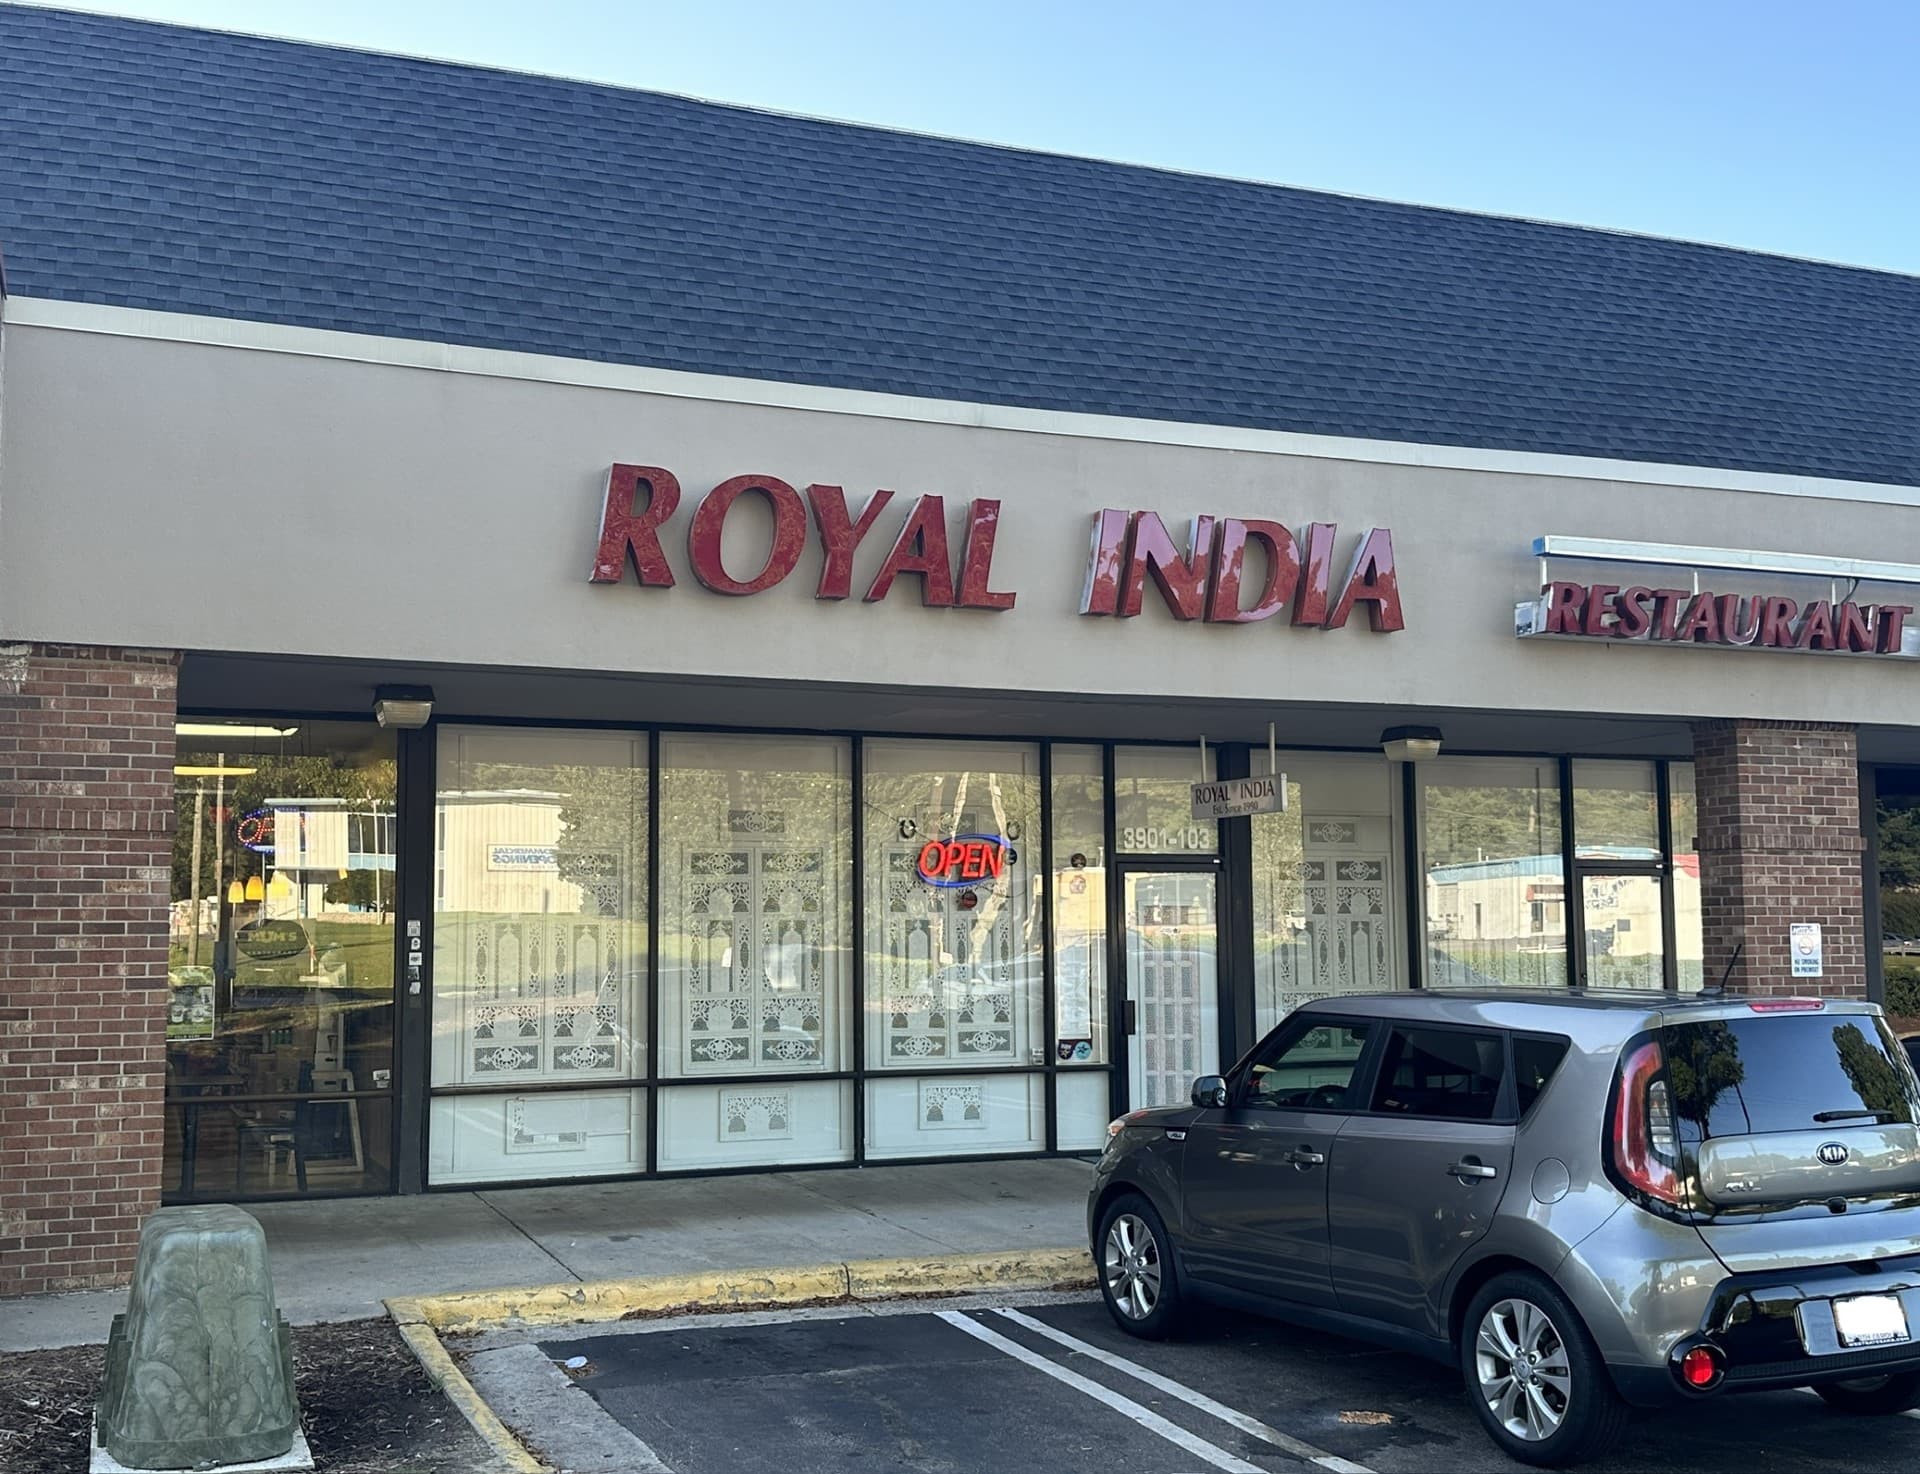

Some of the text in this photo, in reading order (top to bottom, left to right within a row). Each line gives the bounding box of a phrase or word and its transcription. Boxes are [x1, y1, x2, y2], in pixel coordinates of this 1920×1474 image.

[588, 462, 1913, 654] ROYAL INDIA RESTAURANT
[1195, 780, 1275, 805] ROYAL INDIA
[1123, 827, 1210, 849] 3901-103
[919, 841, 1005, 878] OPEN
[1822, 1146, 1846, 1161] KIA
